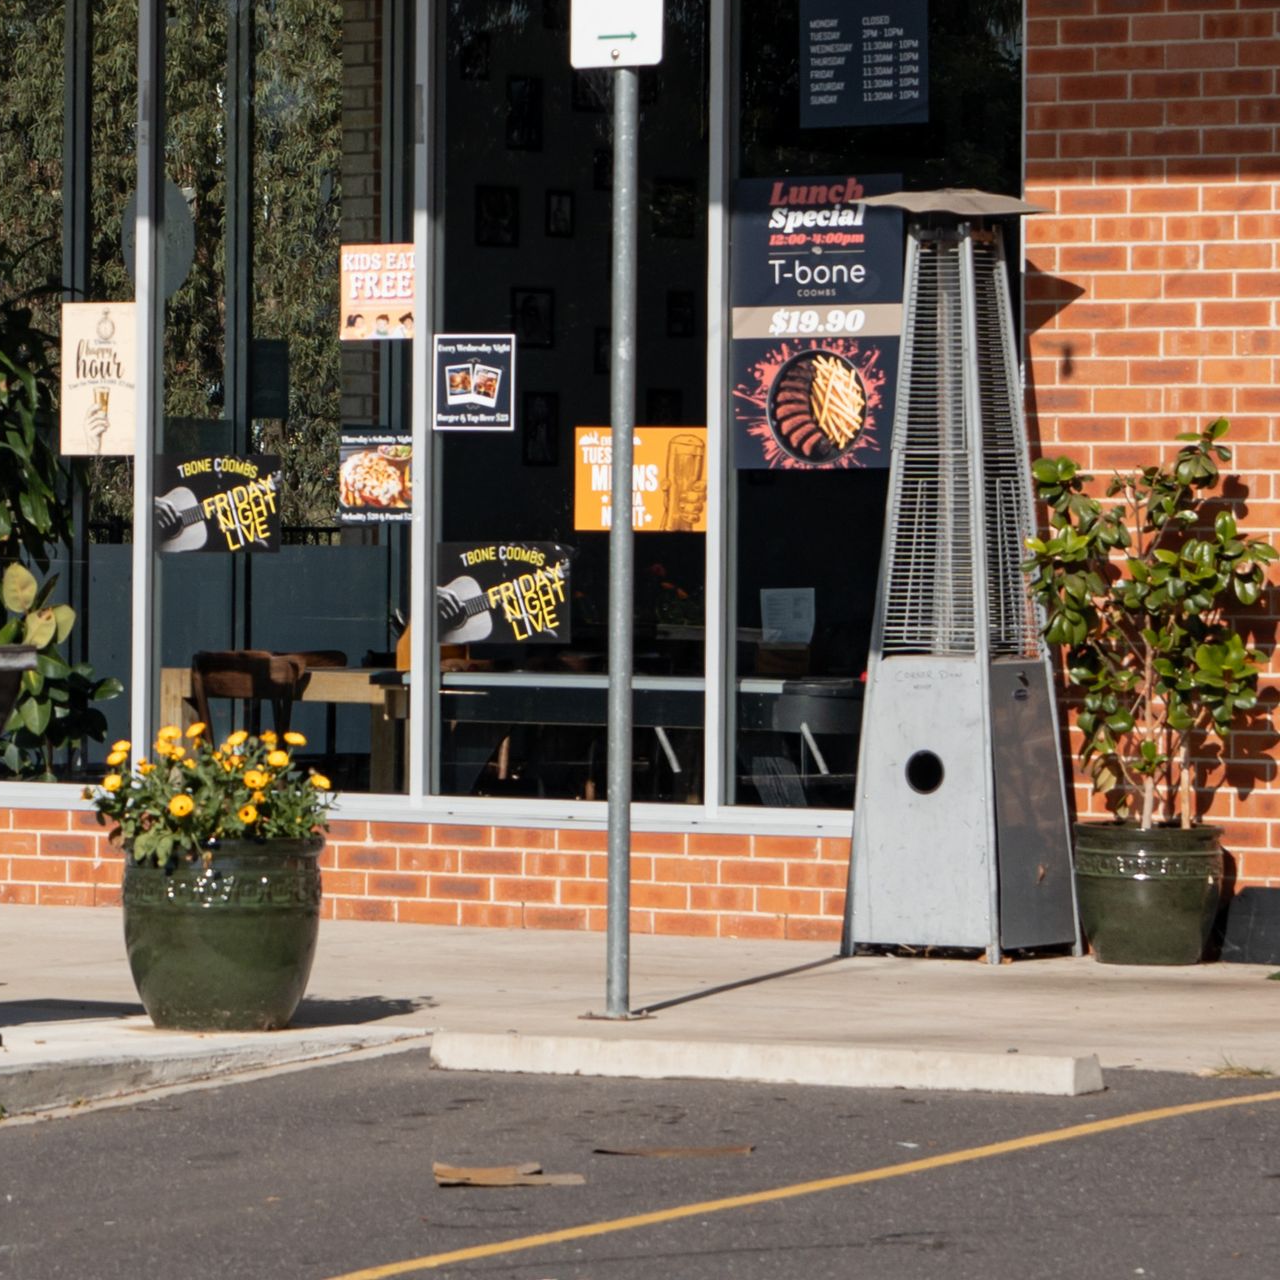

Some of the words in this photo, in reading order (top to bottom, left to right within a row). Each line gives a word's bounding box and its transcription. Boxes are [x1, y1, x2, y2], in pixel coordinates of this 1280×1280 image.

[809, 19, 839, 29] MONDAY
[862, 15, 890, 26] CLOSED
[810, 31, 841, 41] TUESDAY
[809, 43, 853, 54] WEDNESDAY
[810, 57, 846, 66] THURSDAY
[810, 70, 835, 79] FRIDAY
[810, 82, 845, 92] SATURDAY
[810, 95, 838, 105] SUNDAY
[769, 176, 864, 206] Lunch
[768, 204, 866, 234] Special
[343, 252, 382, 272] KIDS
[385, 251, 416, 271] EAT
[768, 259, 866, 286] T-bone
[350, 271, 414, 299] FREE
[797, 288, 837, 297] COOMBS
[768, 308, 866, 337] $19.90
[76, 338, 125, 379] hour
[85, 340, 113, 359] happy
[177, 458, 213, 478] TBONE
[214, 458, 258, 479] COOMBS
[203, 474, 276, 520] FRIDAY
[217, 492, 276, 533] NIGHT
[226, 516, 271, 551] LIVE
[460, 546, 496, 567] TBONE
[498, 546, 546, 566] COOMBS
[487, 562, 560, 609] FRIDAY
[503, 580, 565, 623] NIGHT
[511, 605, 560, 641] LIVE
